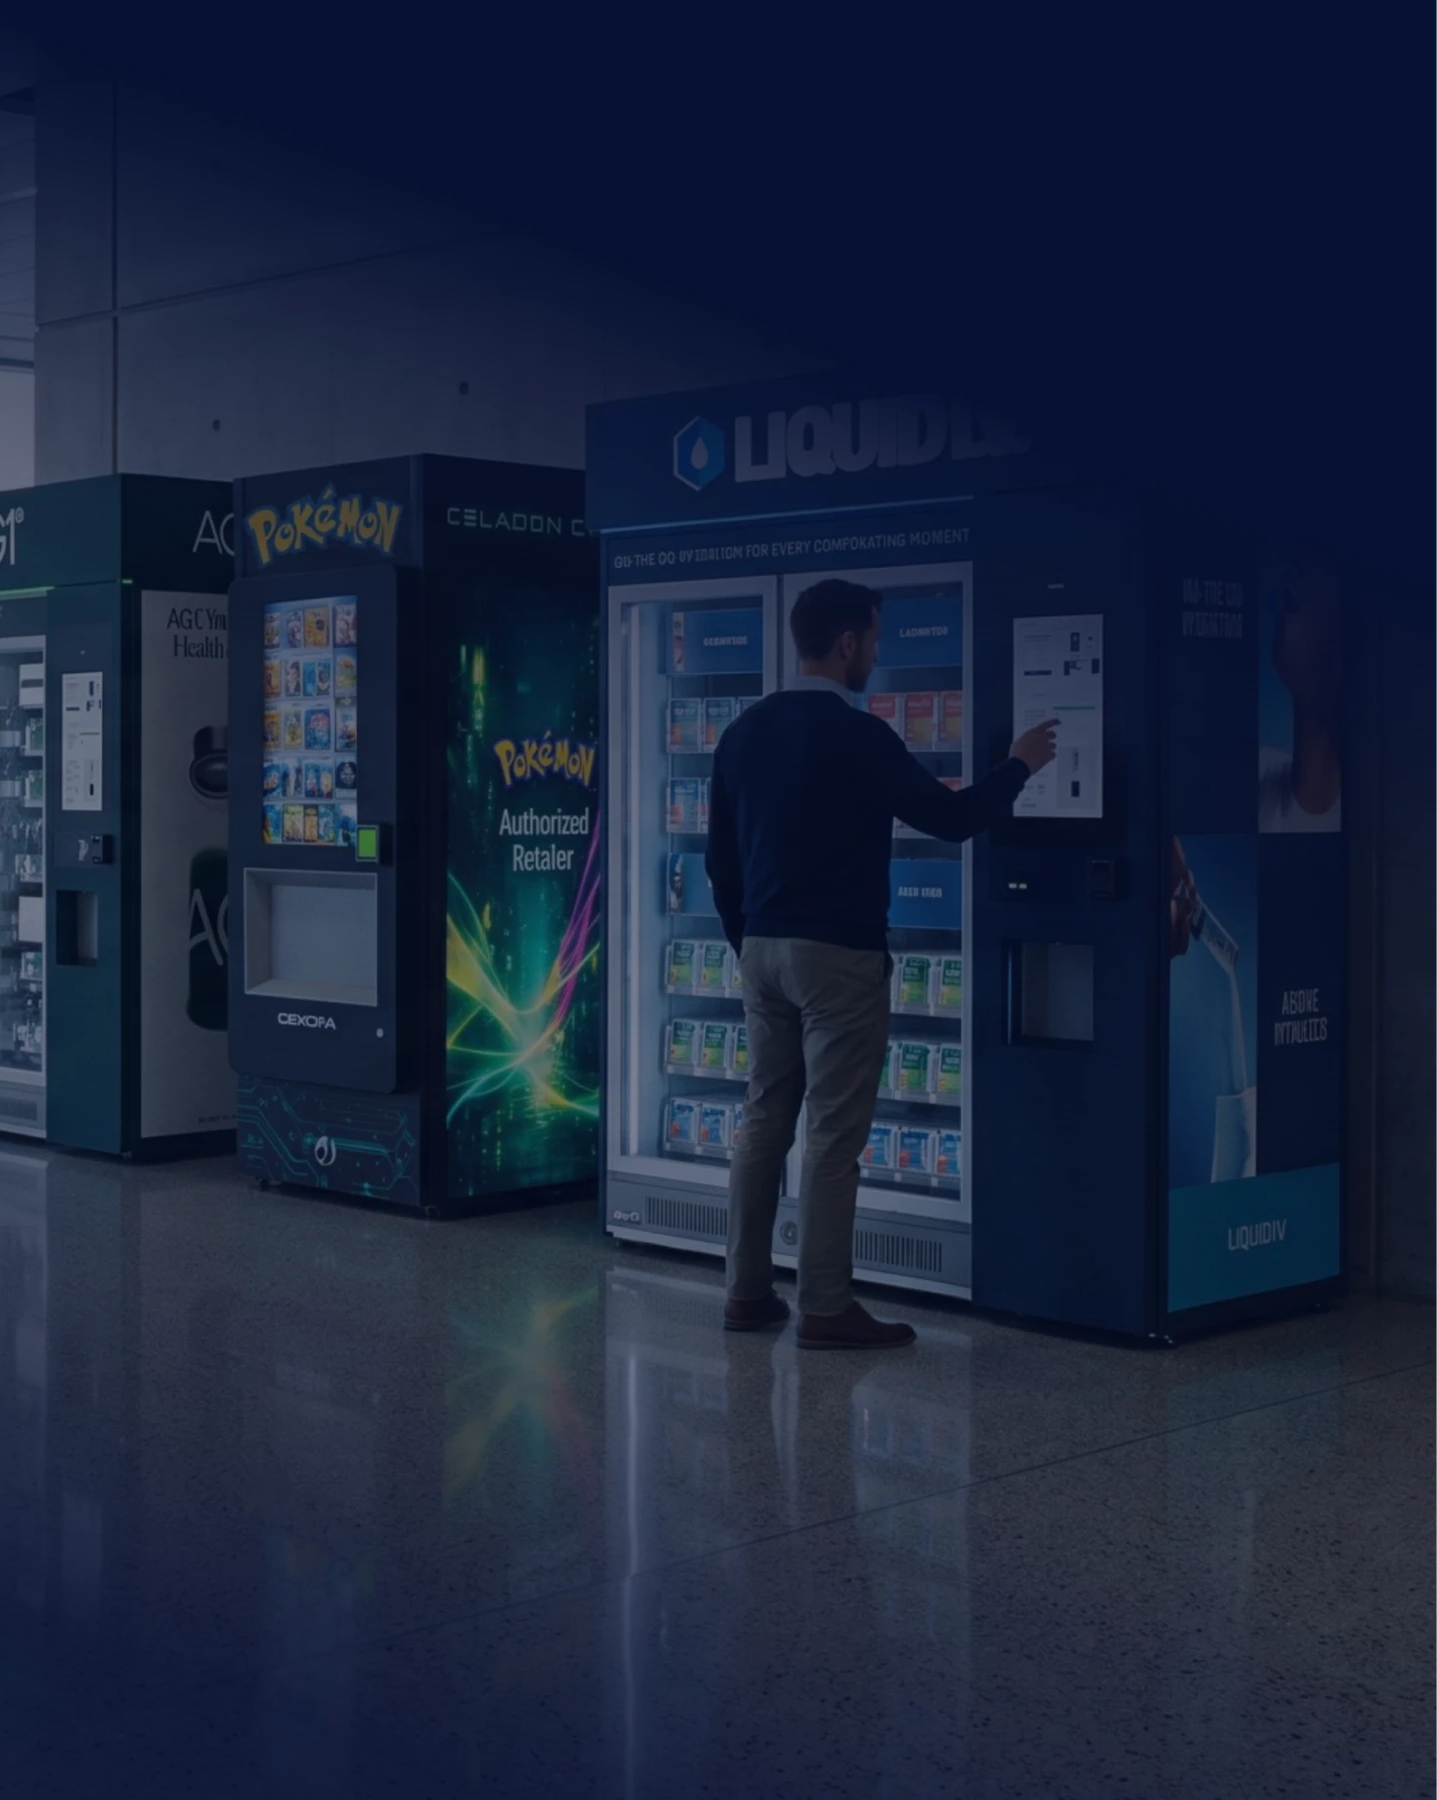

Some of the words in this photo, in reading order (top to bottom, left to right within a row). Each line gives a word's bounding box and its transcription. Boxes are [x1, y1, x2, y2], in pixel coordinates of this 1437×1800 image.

[447, 507, 562, 534] CELADON
[571, 519, 592, 537] C
[746, 543, 769, 558] FOR
[771, 539, 811, 557] EVERY
[910, 526, 970, 546] MOMENT
[173, 633, 224, 660] Health
[499, 806, 589, 836] Authorized
